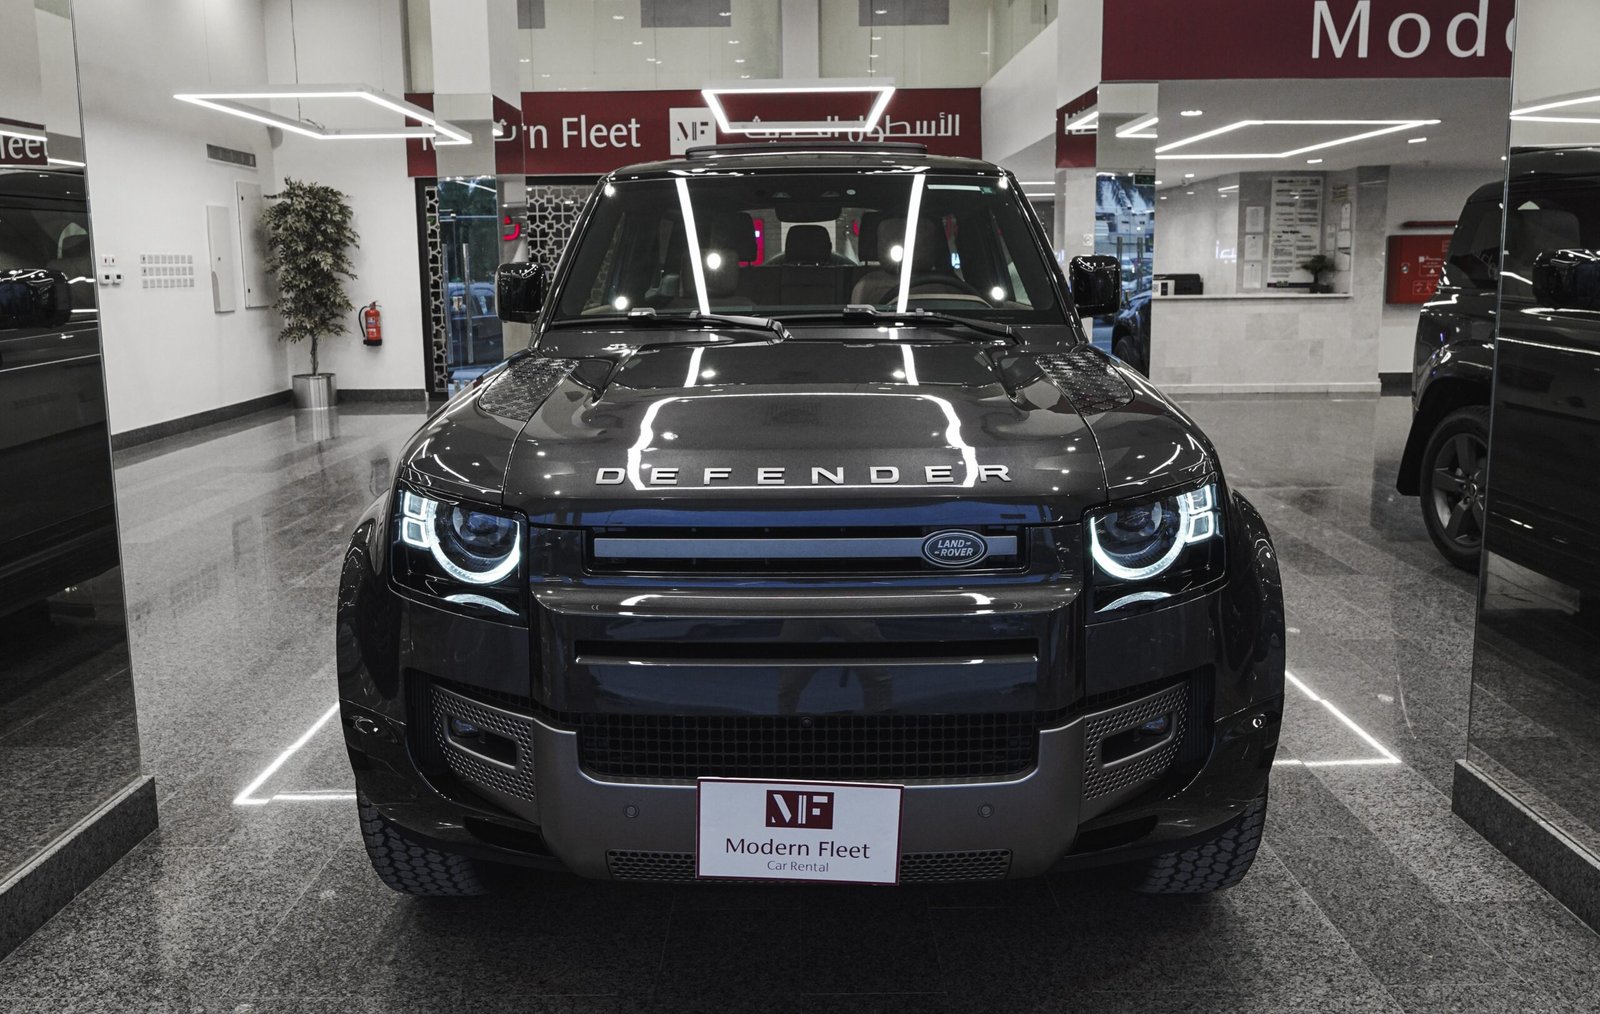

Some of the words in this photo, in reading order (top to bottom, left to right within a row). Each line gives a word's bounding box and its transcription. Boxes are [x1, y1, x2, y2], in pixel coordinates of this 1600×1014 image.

[562, 114, 641, 149] Fleet
[595, 464, 1011, 486] DEFENDER
[725, 838, 810, 857] Modern
[818, 841, 871, 859] Fleet
[767, 860, 787, 871] Car
[790, 861, 829, 873] Rental
